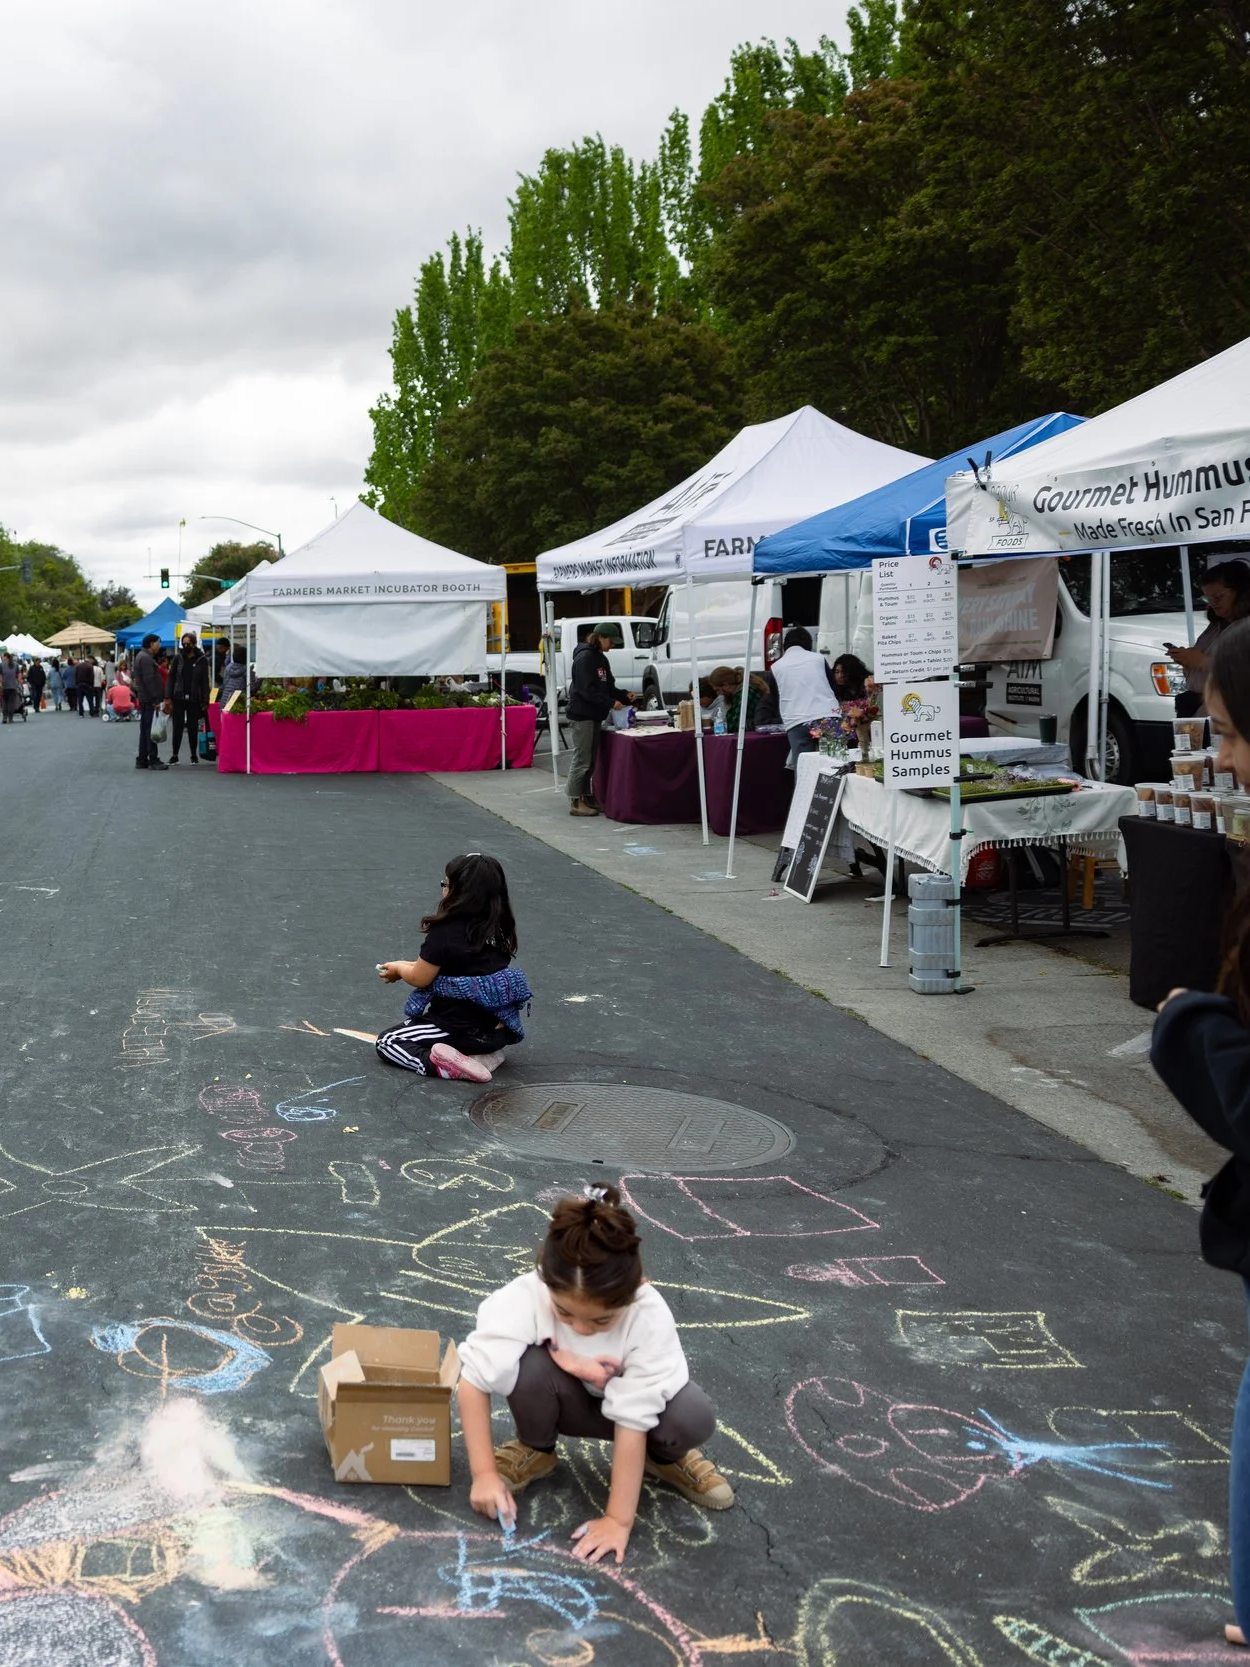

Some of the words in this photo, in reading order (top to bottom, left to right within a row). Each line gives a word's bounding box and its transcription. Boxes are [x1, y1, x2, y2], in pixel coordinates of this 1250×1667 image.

[1033, 476, 1138, 513] Gourmet
[1074, 522, 1116, 542] Made
[1119, 513, 1163, 537] Fresh
[1168, 511, 1191, 532] In
[1195, 506, 1235, 529] San
[996, 537, 1023, 547] FOODS
[578, 559, 605, 576] MARKET
[605, 549, 657, 575] INFORMATION
[273, 587, 323, 597] FARMERS
[326, 586, 370, 595] MARKET
[374, 584, 438, 594] INCUBATOR
[442, 583, 481, 592] BOOTH
[1007, 661, 1042, 680] AIM
[890, 729, 952, 743] Gourmet
[891, 748, 952, 760] Hummus
[892, 763, 950, 778] Samples
[383, 1415, 414, 1424] Thank
[417, 1417, 436, 1426] you
